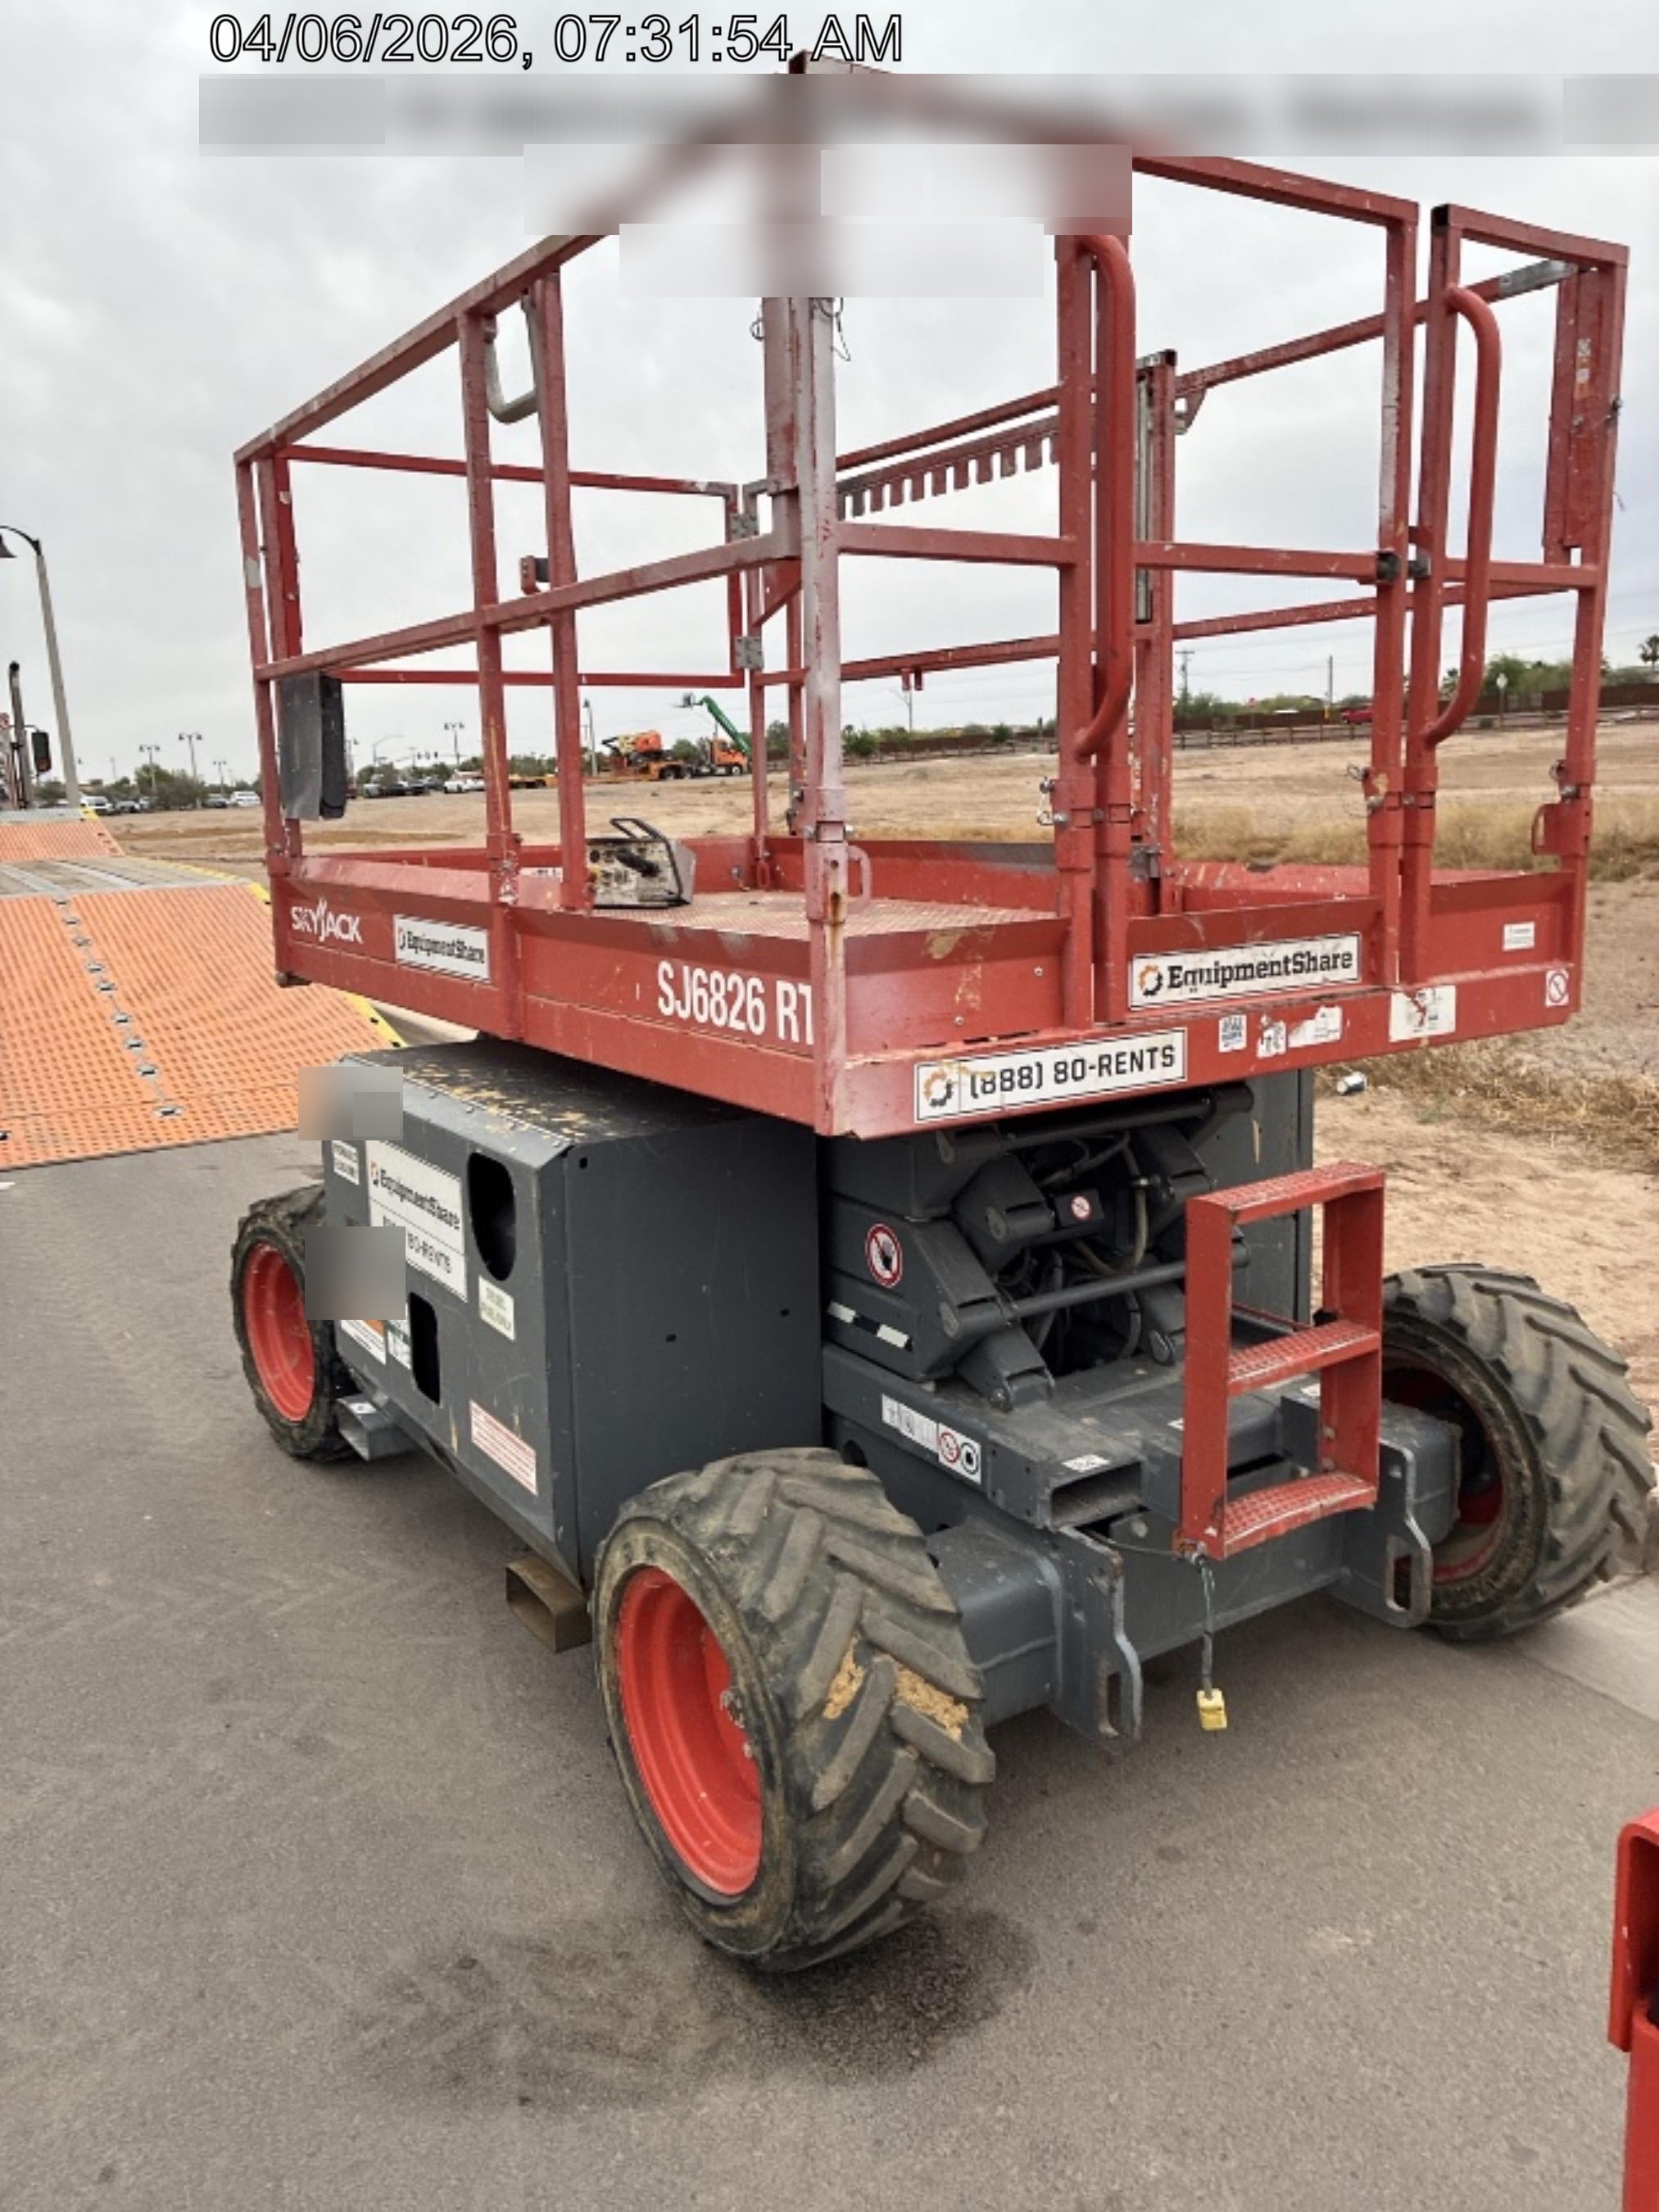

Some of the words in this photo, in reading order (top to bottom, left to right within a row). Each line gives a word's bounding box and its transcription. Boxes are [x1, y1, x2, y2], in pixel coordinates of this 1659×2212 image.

[291, 898, 363, 944] SKYJACK
[406, 931, 485, 964] EquipmentShare
[1167, 950, 1353, 993] EquipmentShare
[658, 960, 765, 1036] SJ6826
[970, 1062, 1043, 1099] (888)
[1054, 1044, 1175, 1085] 80-RENTS
